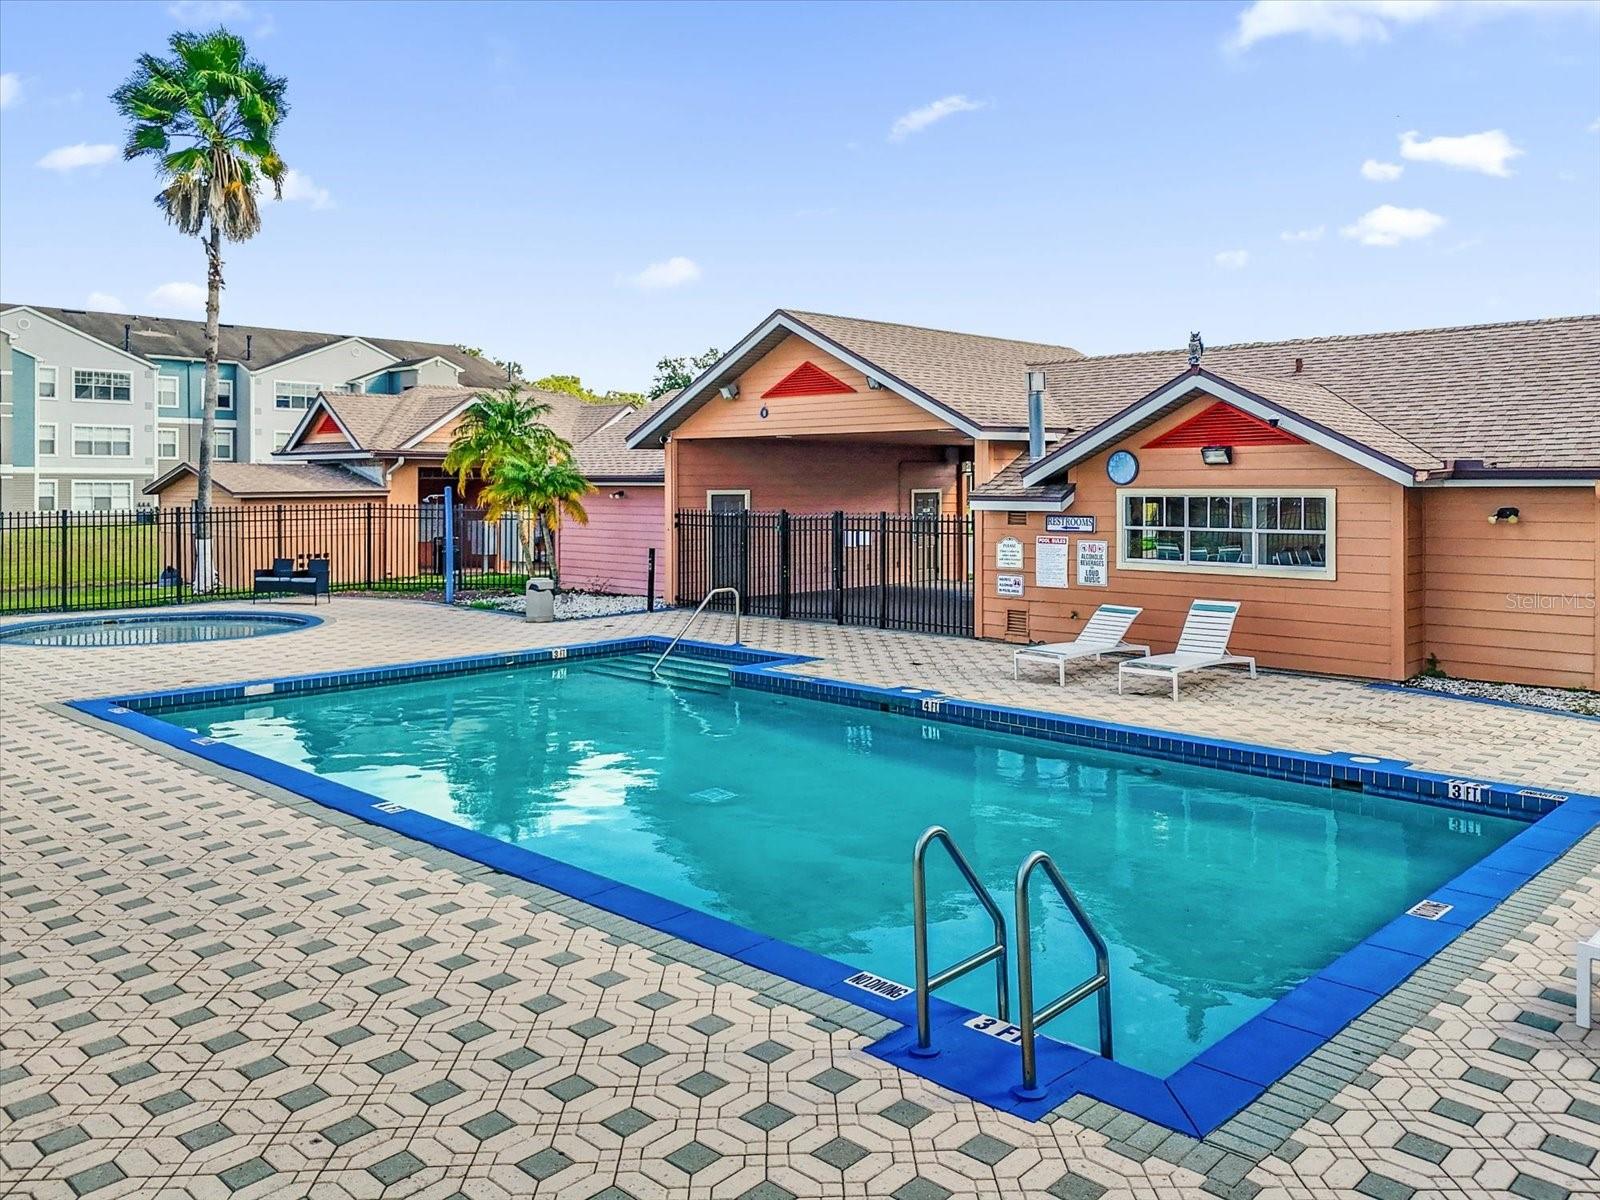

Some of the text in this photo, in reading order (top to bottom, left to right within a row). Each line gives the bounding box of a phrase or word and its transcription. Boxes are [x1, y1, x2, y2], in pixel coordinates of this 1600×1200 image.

[1047, 517, 1094, 527] RESTROOMS
[1088, 544, 1097, 553] NO
[1080, 559, 1105, 567] BEVERAGES
[1085, 569, 1100, 577] LOUD
[1084, 576, 1101, 584] MUSIC
[1452, 784, 1461, 798] 3
[848, 973, 909, 999] NO DIVING
[973, 1018, 998, 1030] 3
